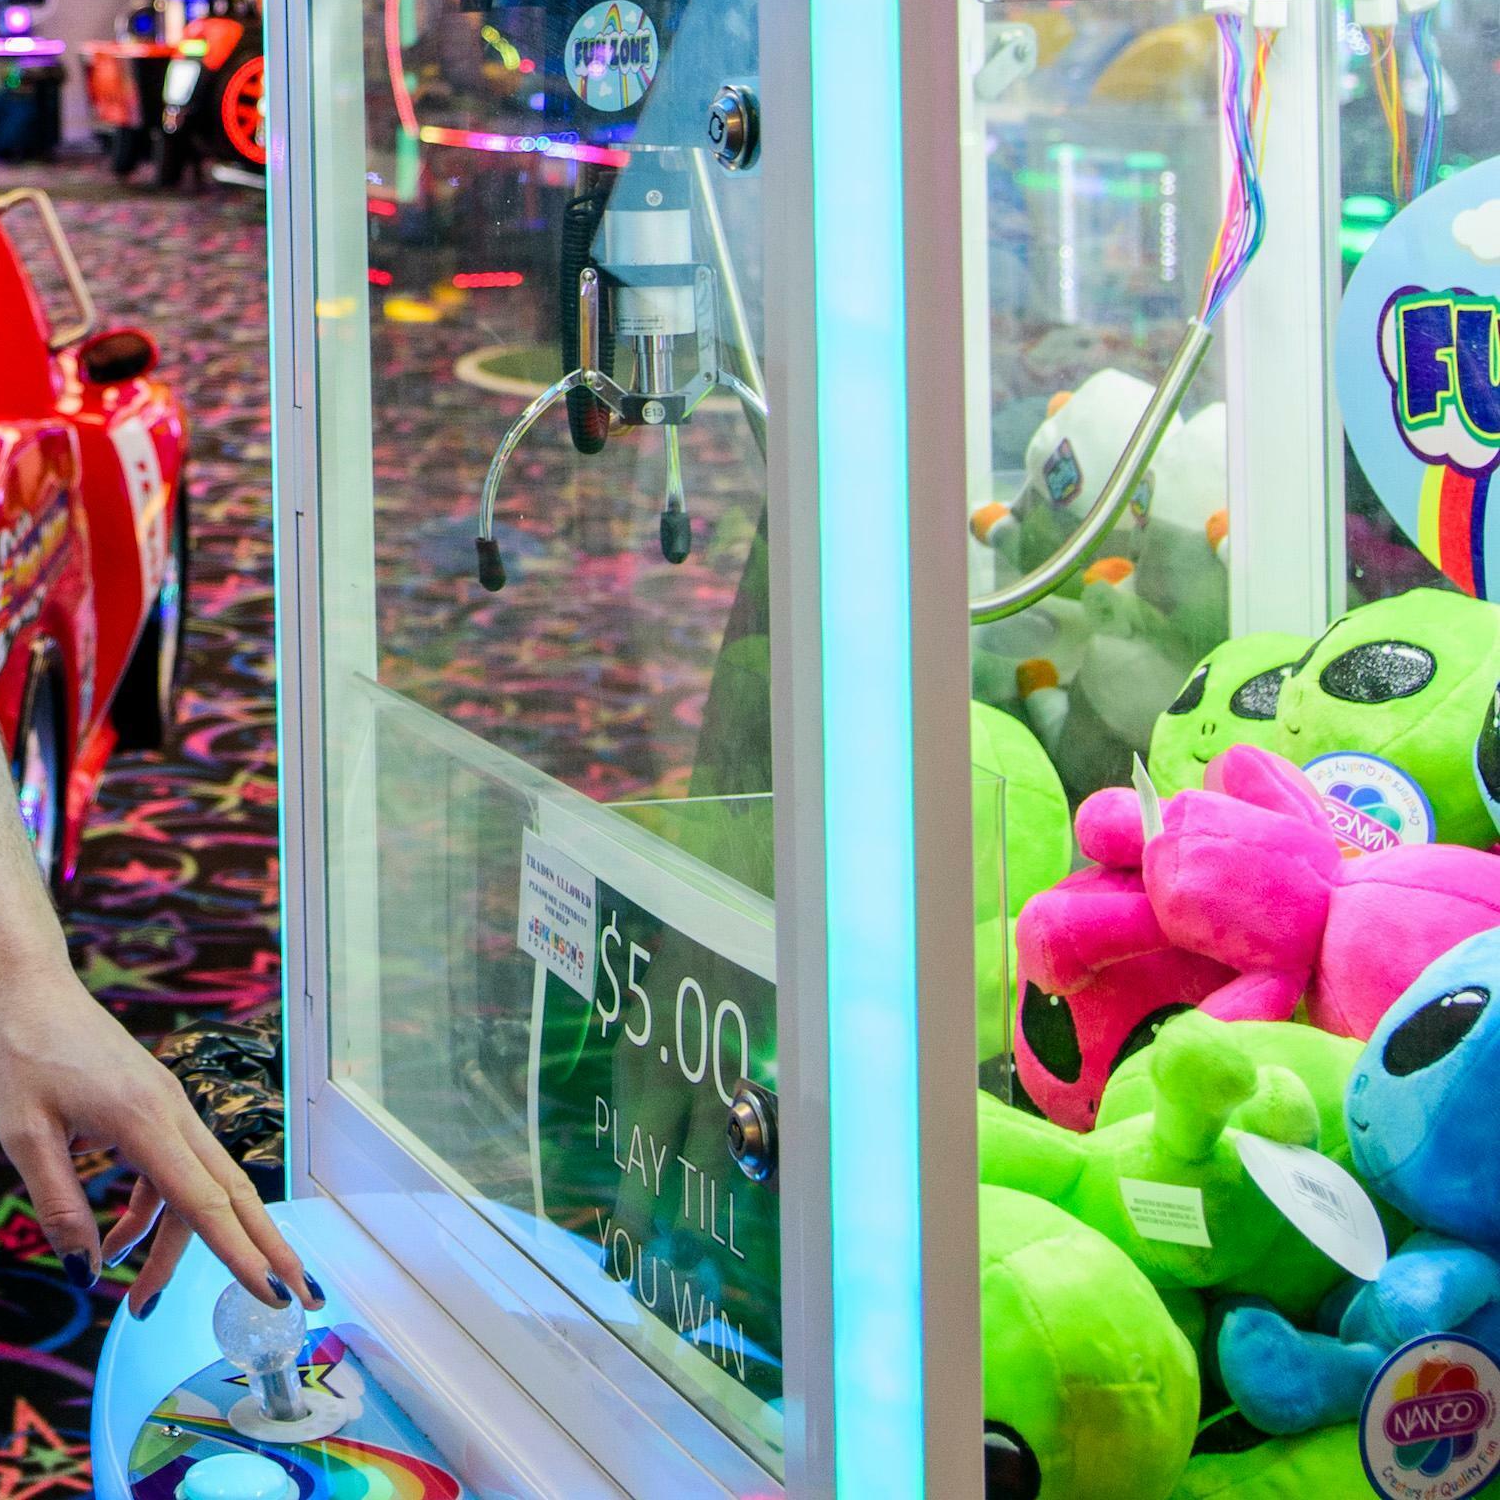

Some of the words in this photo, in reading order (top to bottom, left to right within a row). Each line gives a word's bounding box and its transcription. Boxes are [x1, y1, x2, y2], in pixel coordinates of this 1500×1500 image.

[609, 36, 650, 67] ZONE
[526, 853, 554, 883] TRADES
[556, 875, 591, 909] ALLOWED
[596, 910, 748, 1108] $5.00
[595, 1095, 666, 1196] PLAY
[677, 1155, 744, 1259] TILL
[596, 1208, 657, 1308] YOU
[671, 1270, 745, 1382] WIN
[1395, 1400, 1472, 1438] NANCO
[1440, 1464, 1484, 1497] Quality
[1478, 1440, 1499, 1463] Fun
